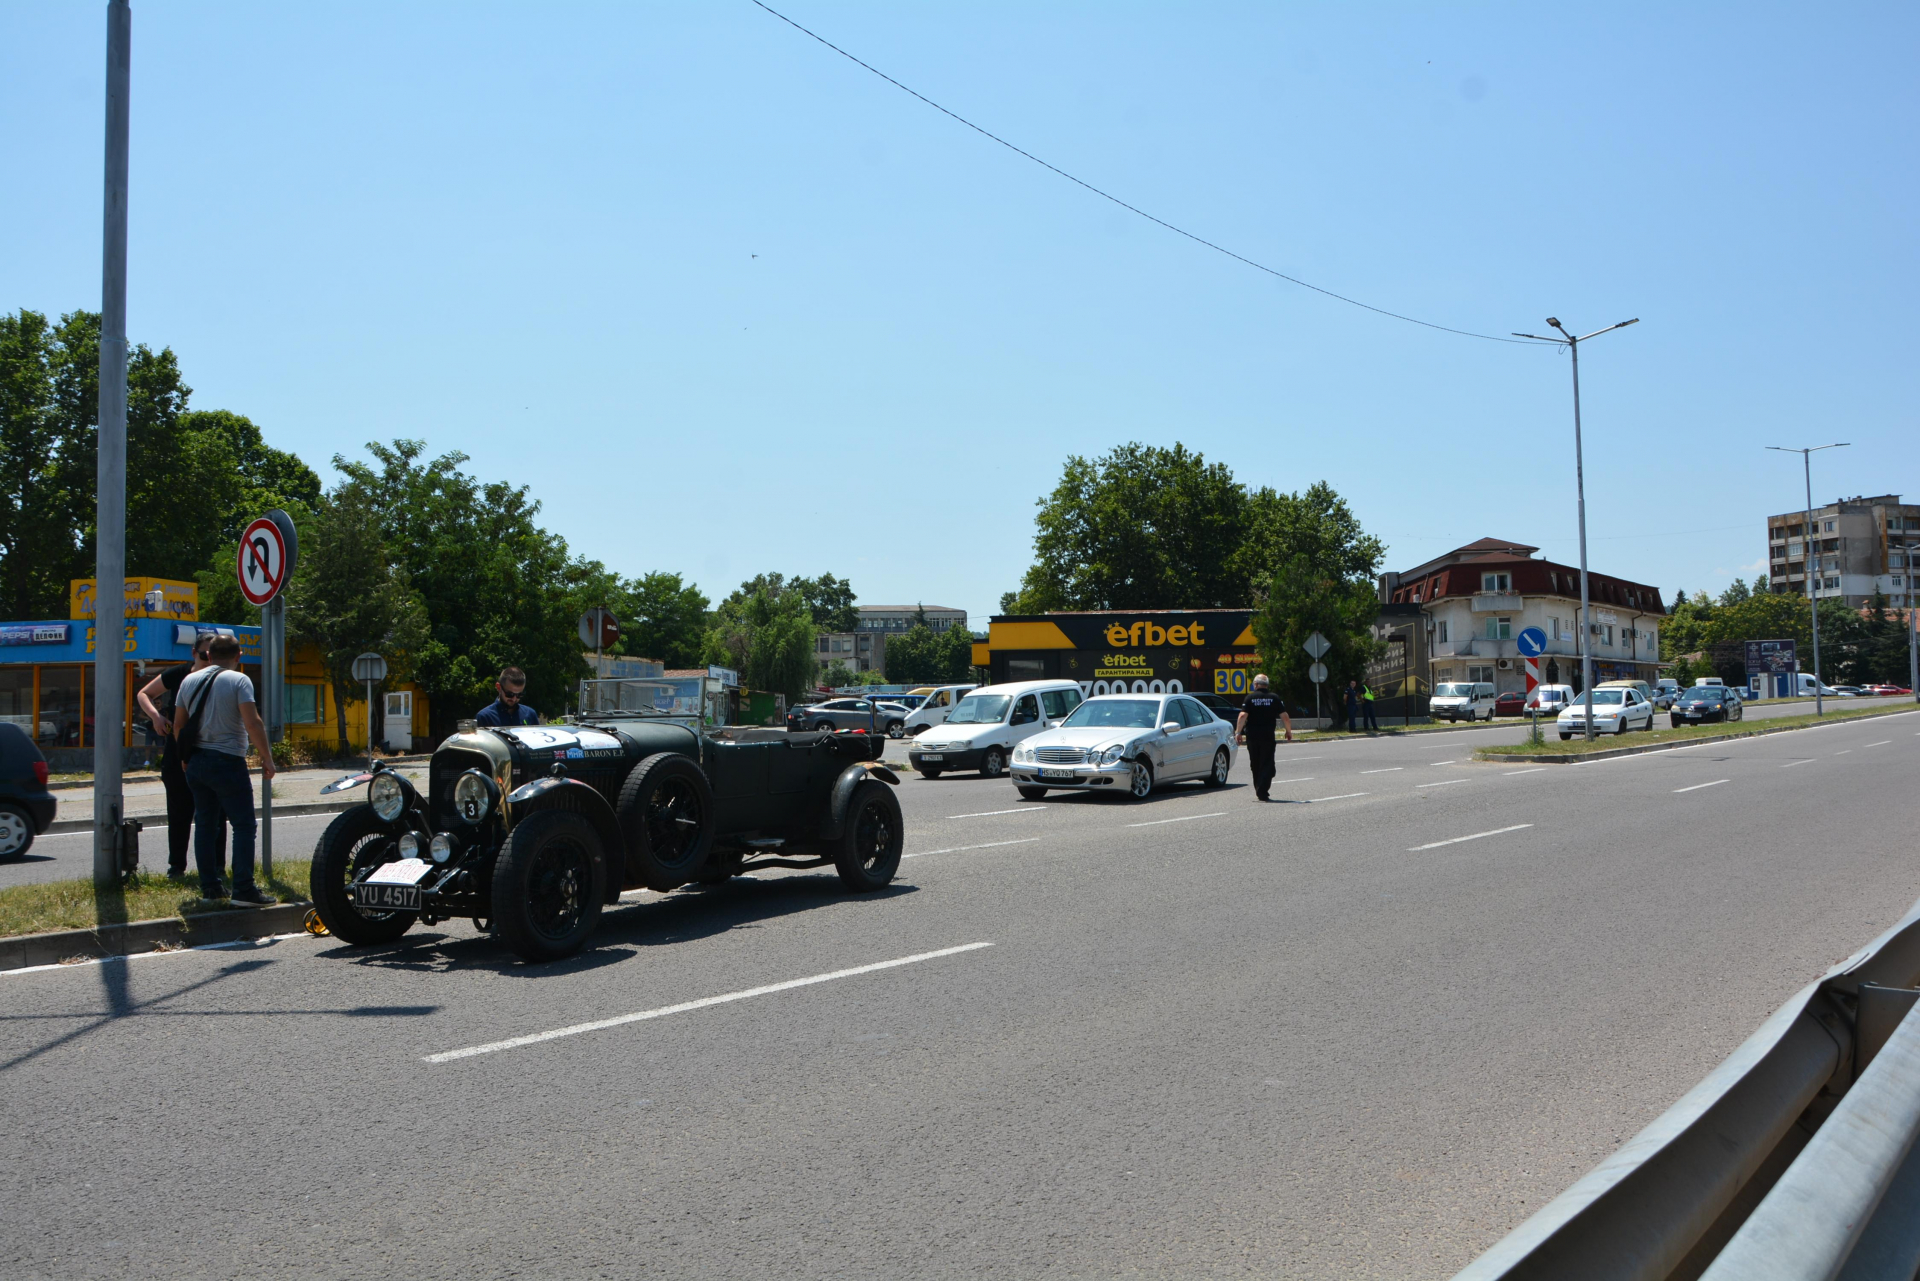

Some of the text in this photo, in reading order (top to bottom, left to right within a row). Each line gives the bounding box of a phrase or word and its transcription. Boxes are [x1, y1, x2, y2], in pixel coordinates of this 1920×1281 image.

[1107, 620, 1205, 647] efbet
[1103, 654, 1146, 667] efbet
[533, 731, 557, 743] 3
[584, 750, 612, 758] BARON
[468, 803, 475, 816] 3
[360, 886, 417, 906] YU 4517
